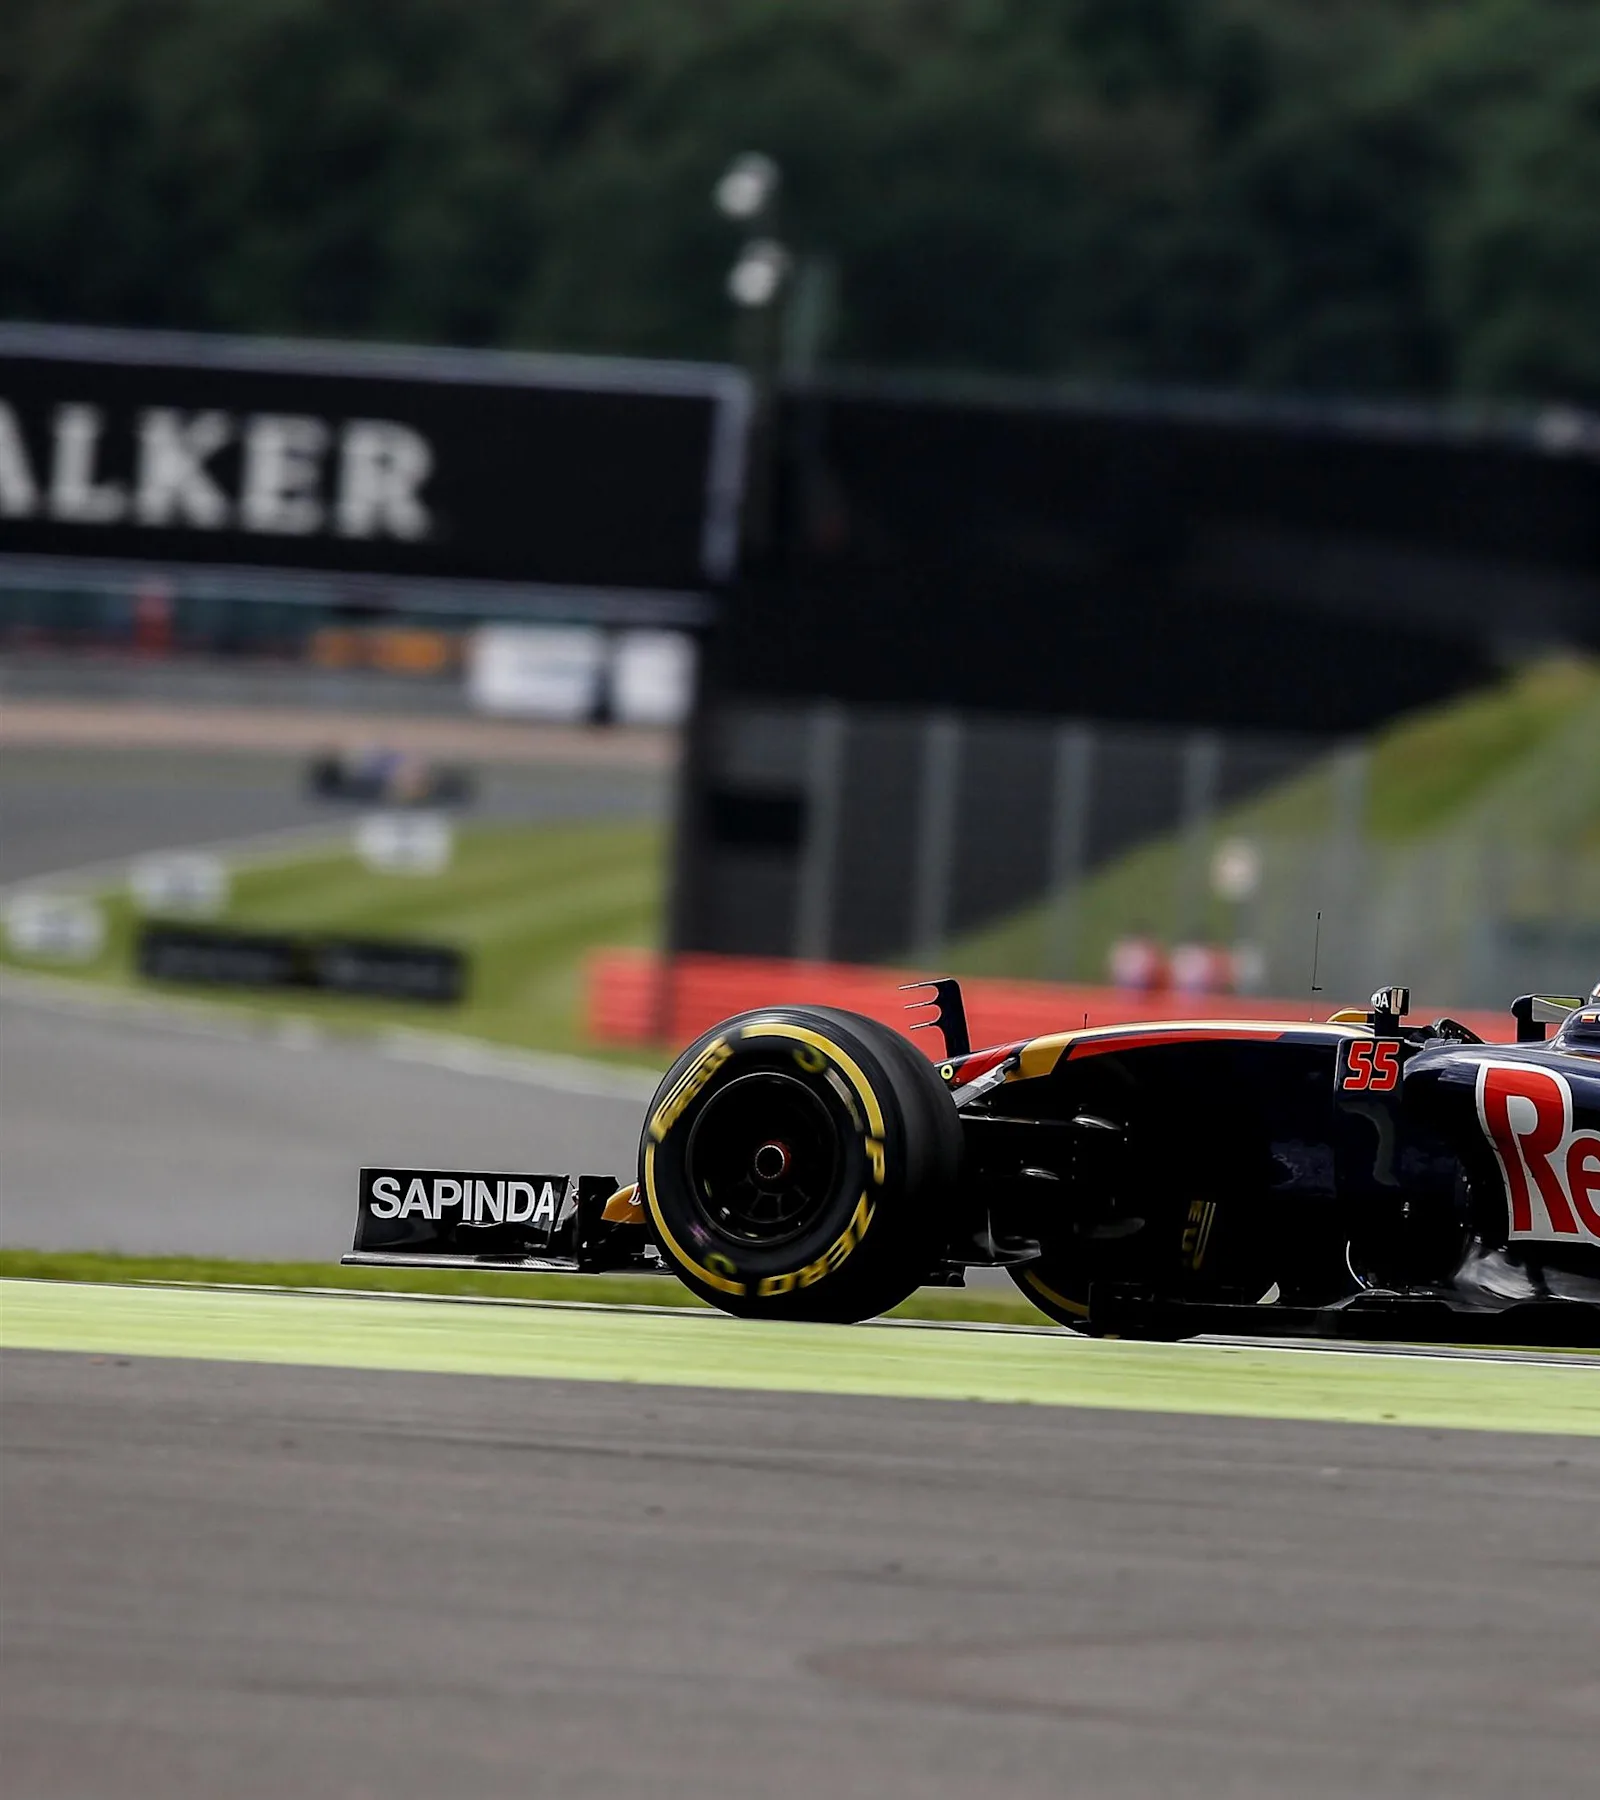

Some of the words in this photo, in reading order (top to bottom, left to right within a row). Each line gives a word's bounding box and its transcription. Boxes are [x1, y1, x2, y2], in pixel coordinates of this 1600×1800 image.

[1342, 1040, 1400, 1092] 55
[370, 1176, 555, 1223] SAPINDA
[757, 1190, 877, 1297] ZERO
